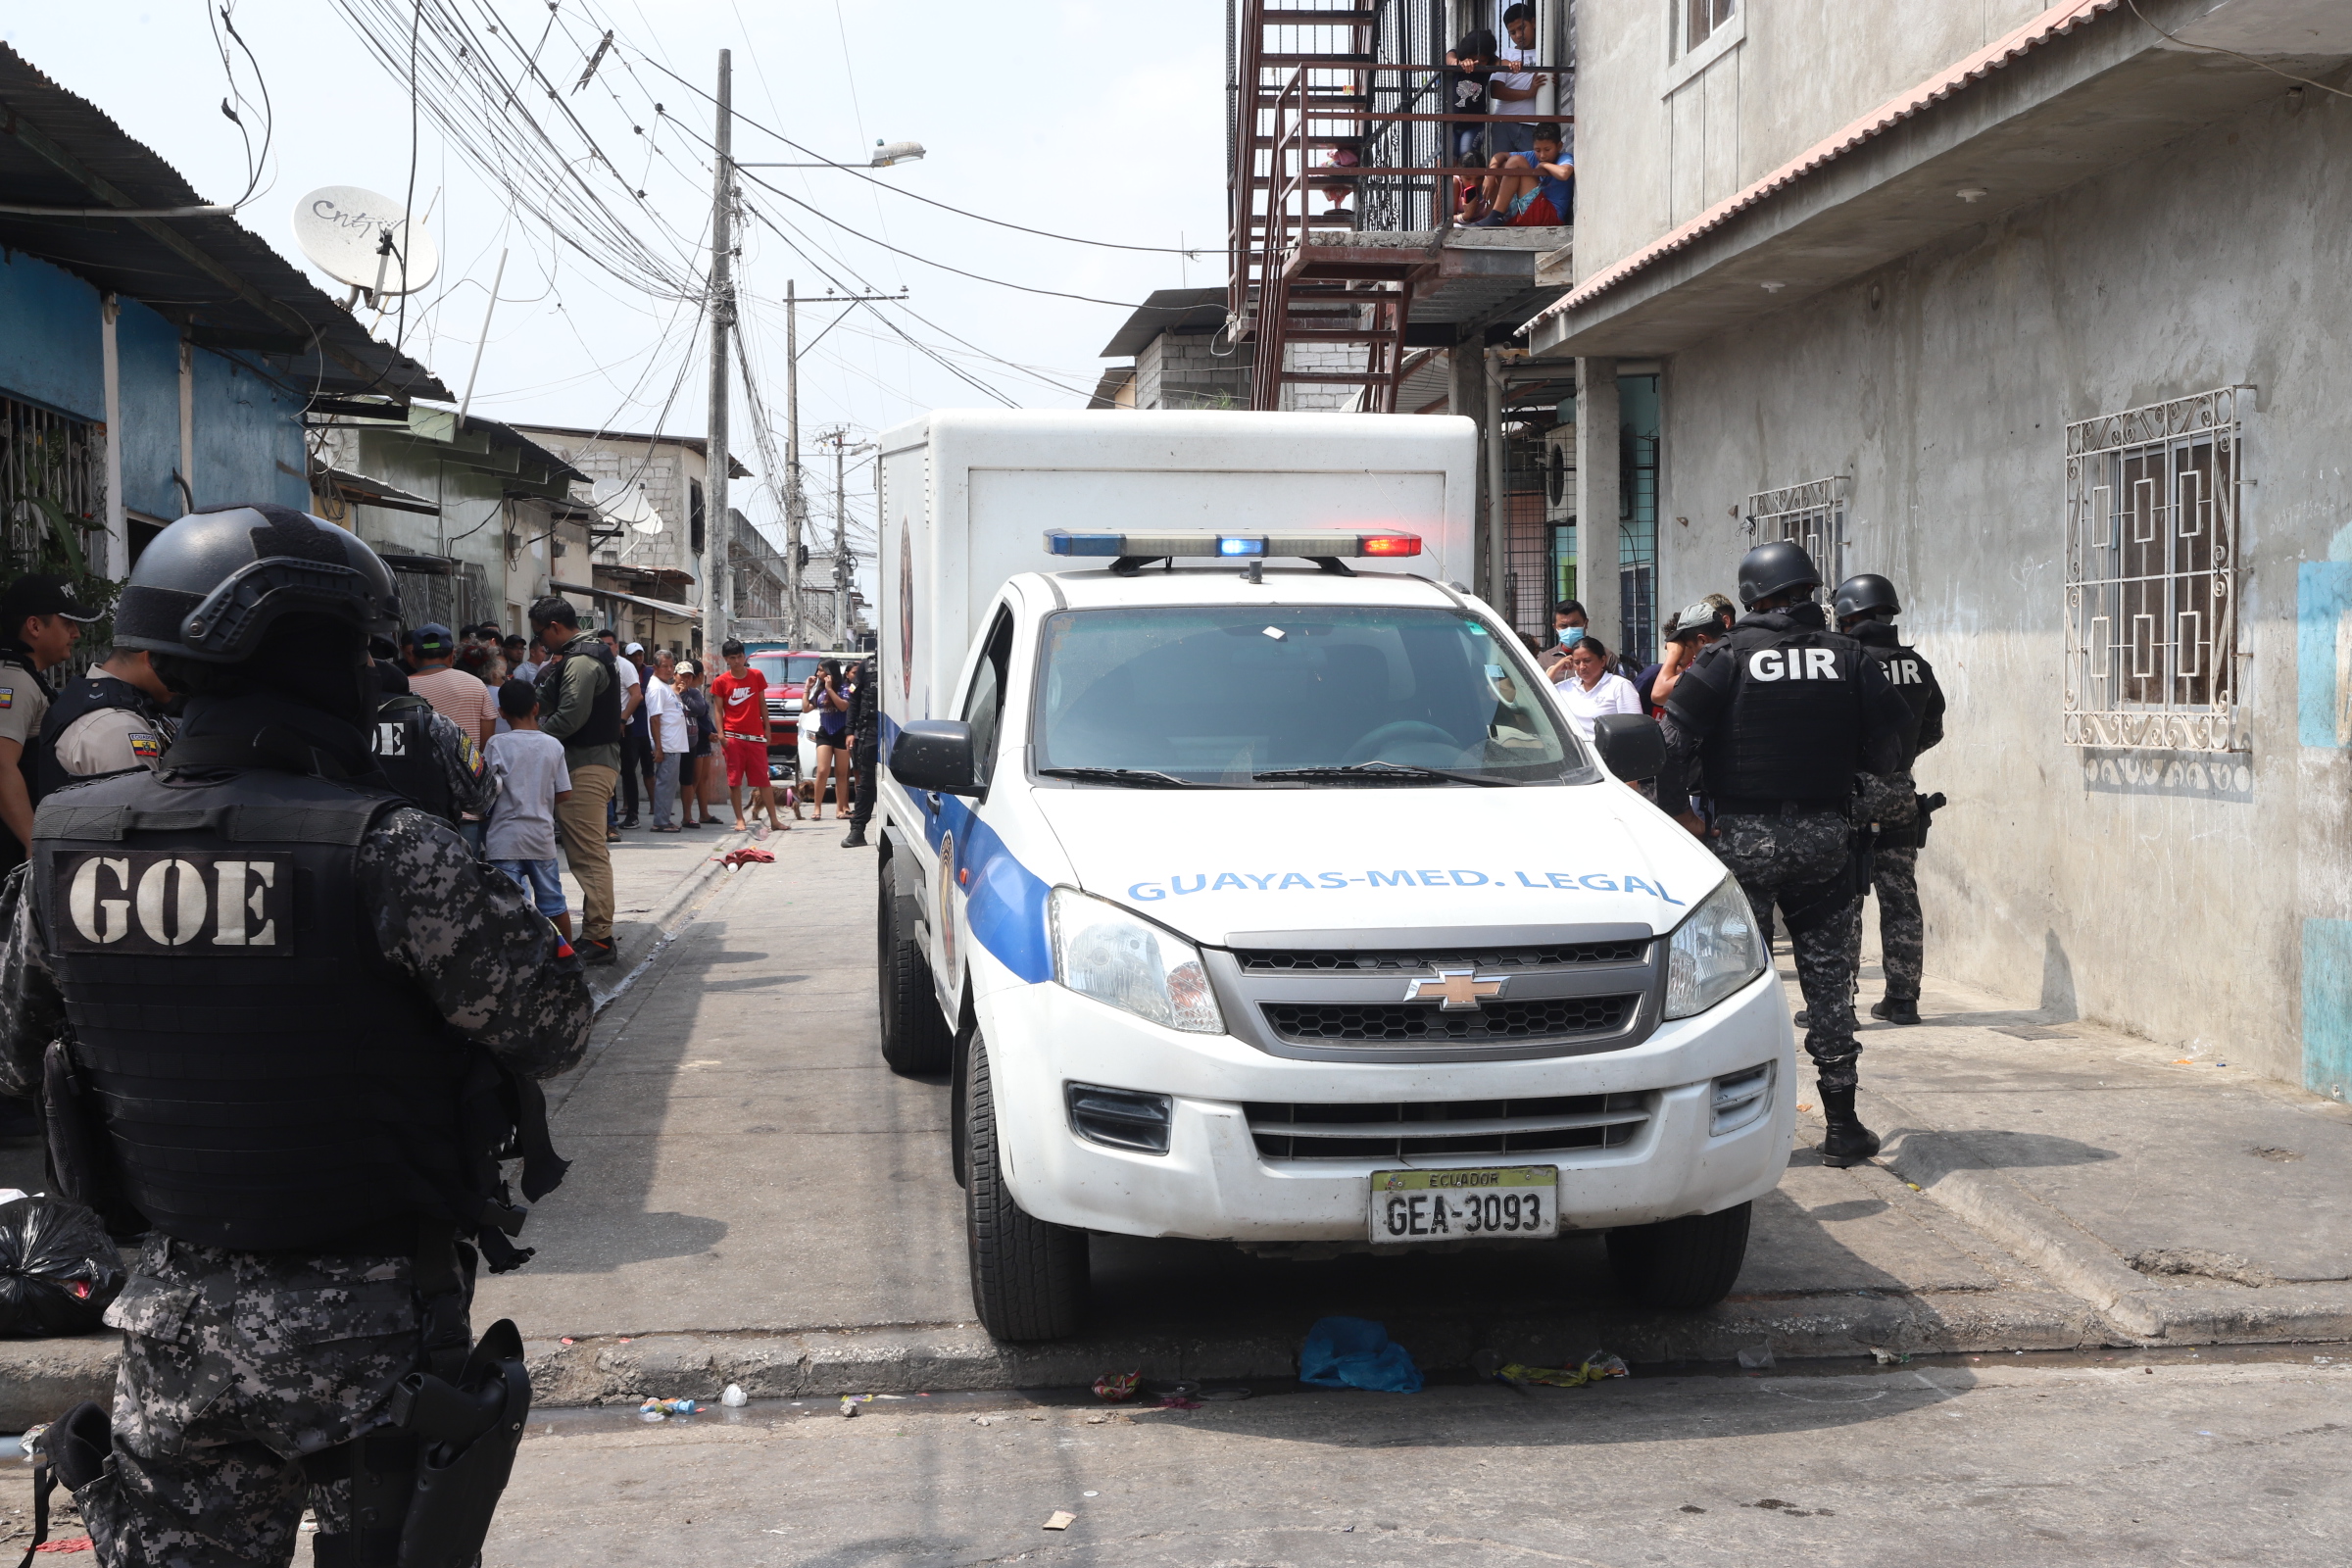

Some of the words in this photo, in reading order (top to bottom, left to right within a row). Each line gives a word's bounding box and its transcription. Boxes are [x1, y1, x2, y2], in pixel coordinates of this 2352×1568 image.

[1749, 649, 1838, 681] GIR
[732, 687, 751, 698] NIKE
[371, 723, 405, 756] E
[70, 857, 275, 945] GOE
[1128, 870, 1505, 902] GUAYAS-MED.
[1514, 871, 1686, 906] LEGAL
[1429, 1172, 1499, 1187] ECUADOR
[1388, 1193, 1541, 1236] GEA-3093
